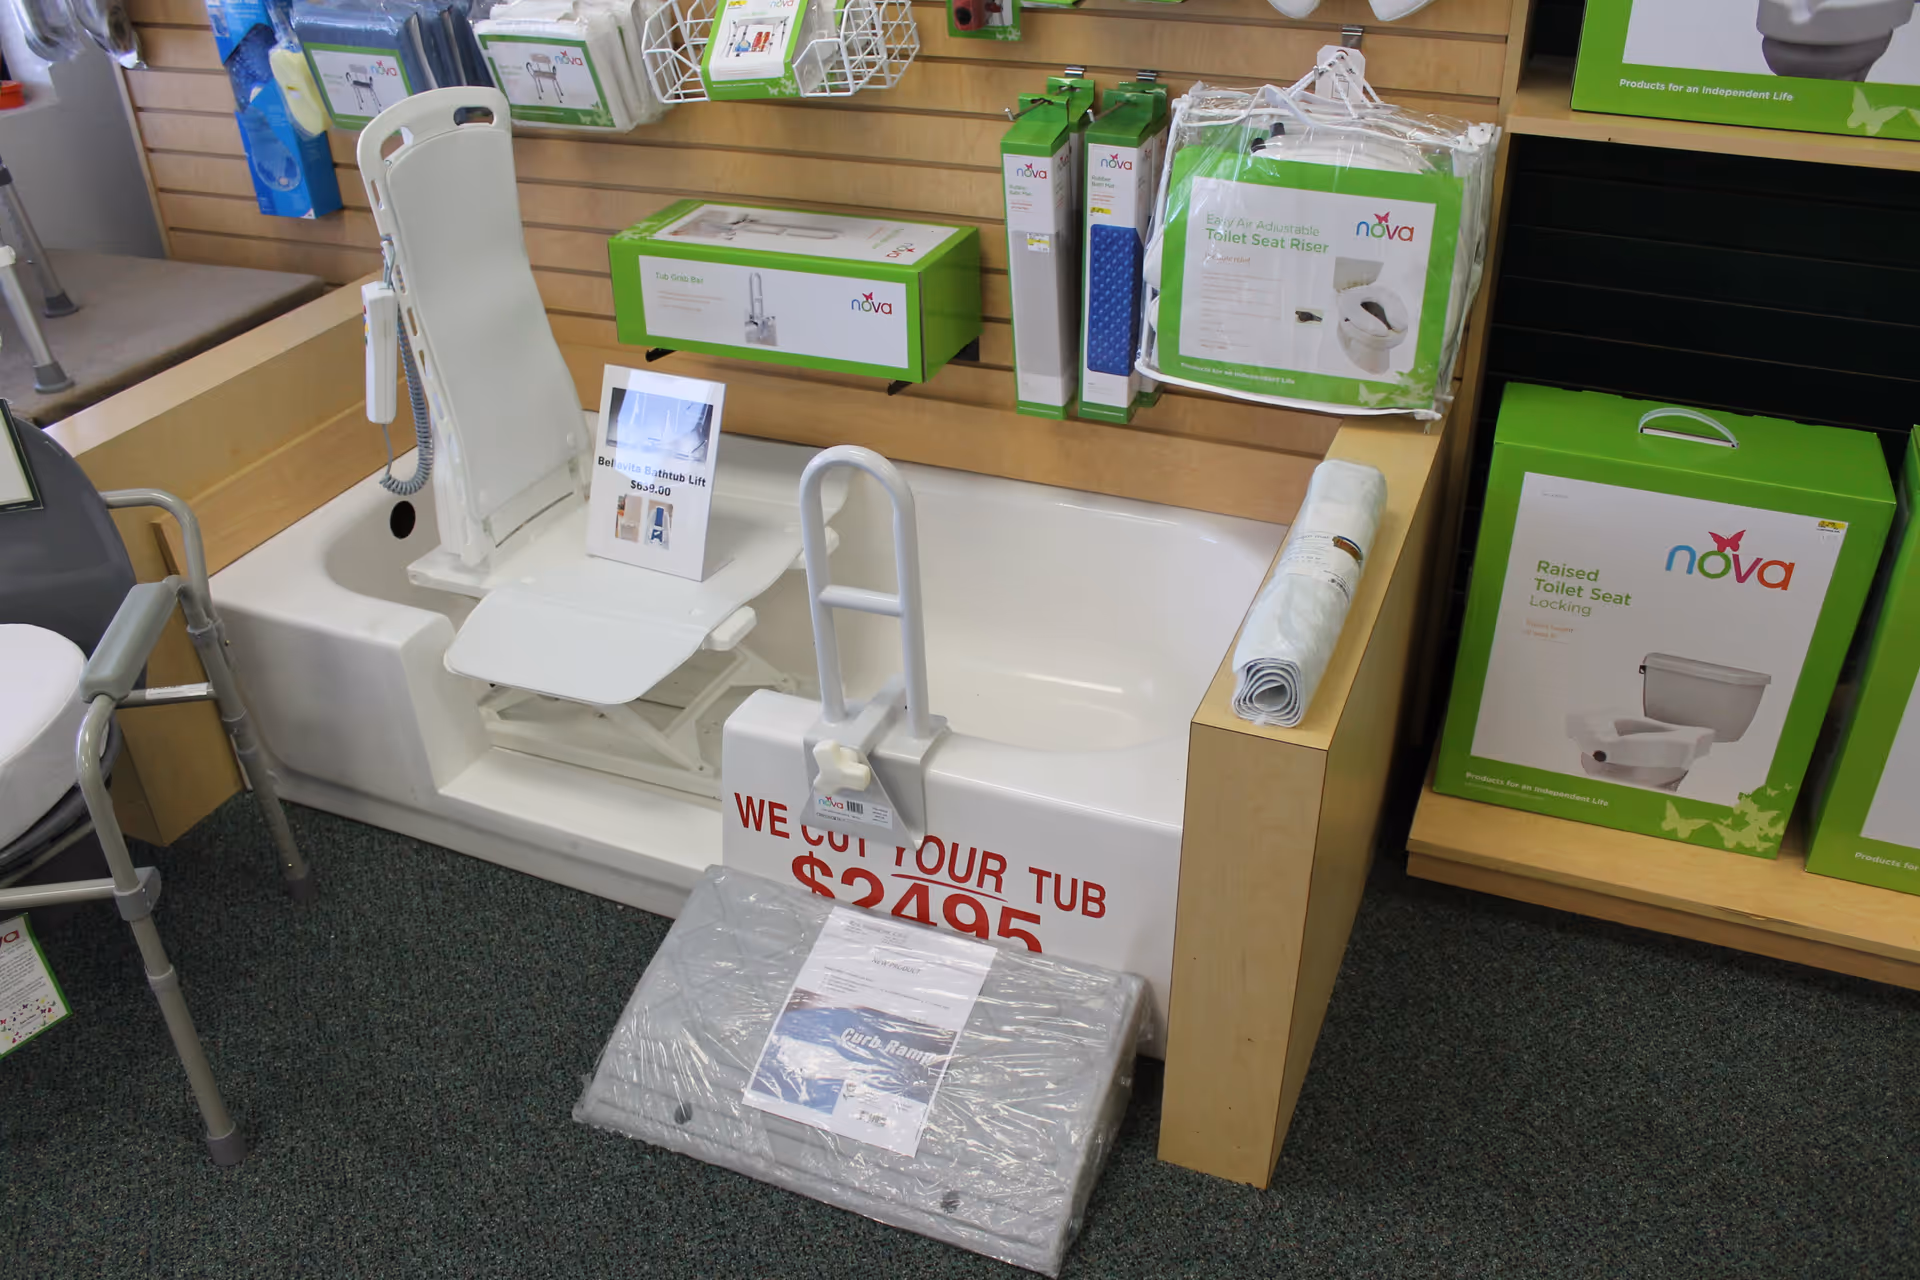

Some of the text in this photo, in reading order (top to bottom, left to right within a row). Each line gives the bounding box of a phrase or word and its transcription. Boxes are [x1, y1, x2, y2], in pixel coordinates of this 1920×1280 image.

[1619, 78, 1793, 101] Products for an Independent Life
[1016, 168, 1047, 179] nova
[1100, 158, 1132, 170] nova
[1206, 213, 1320, 237] Easy Air Adjustable
[1356, 220, 1415, 242] nova
[1205, 228, 1329, 253] Toilet Seat Riser
[851, 299, 892, 315] nova
[644, 465, 685, 482] Bathtub
[688, 475, 706, 487] Lift
[1536, 560, 1600, 582] Raised
[1665, 544, 1795, 591] nova
[1534, 577, 1632, 606] Toilet Seat
[1529, 594, 1592, 617] Locking
[1465, 771, 1504, 786] Products
[1506, 779, 1519, 788] for
[1521, 783, 1532, 791] an
[1534, 786, 1590, 803] Independent
[1592, 797, 1609, 807] Life
[818, 798, 844, 810] nova
[734, 792, 790, 840] WE
[1028, 866, 1107, 919] TUB
[1854, 851, 1919, 871] Products for
[791, 850, 1043, 953] $2495
[840, 1027, 882, 1049] Curb
